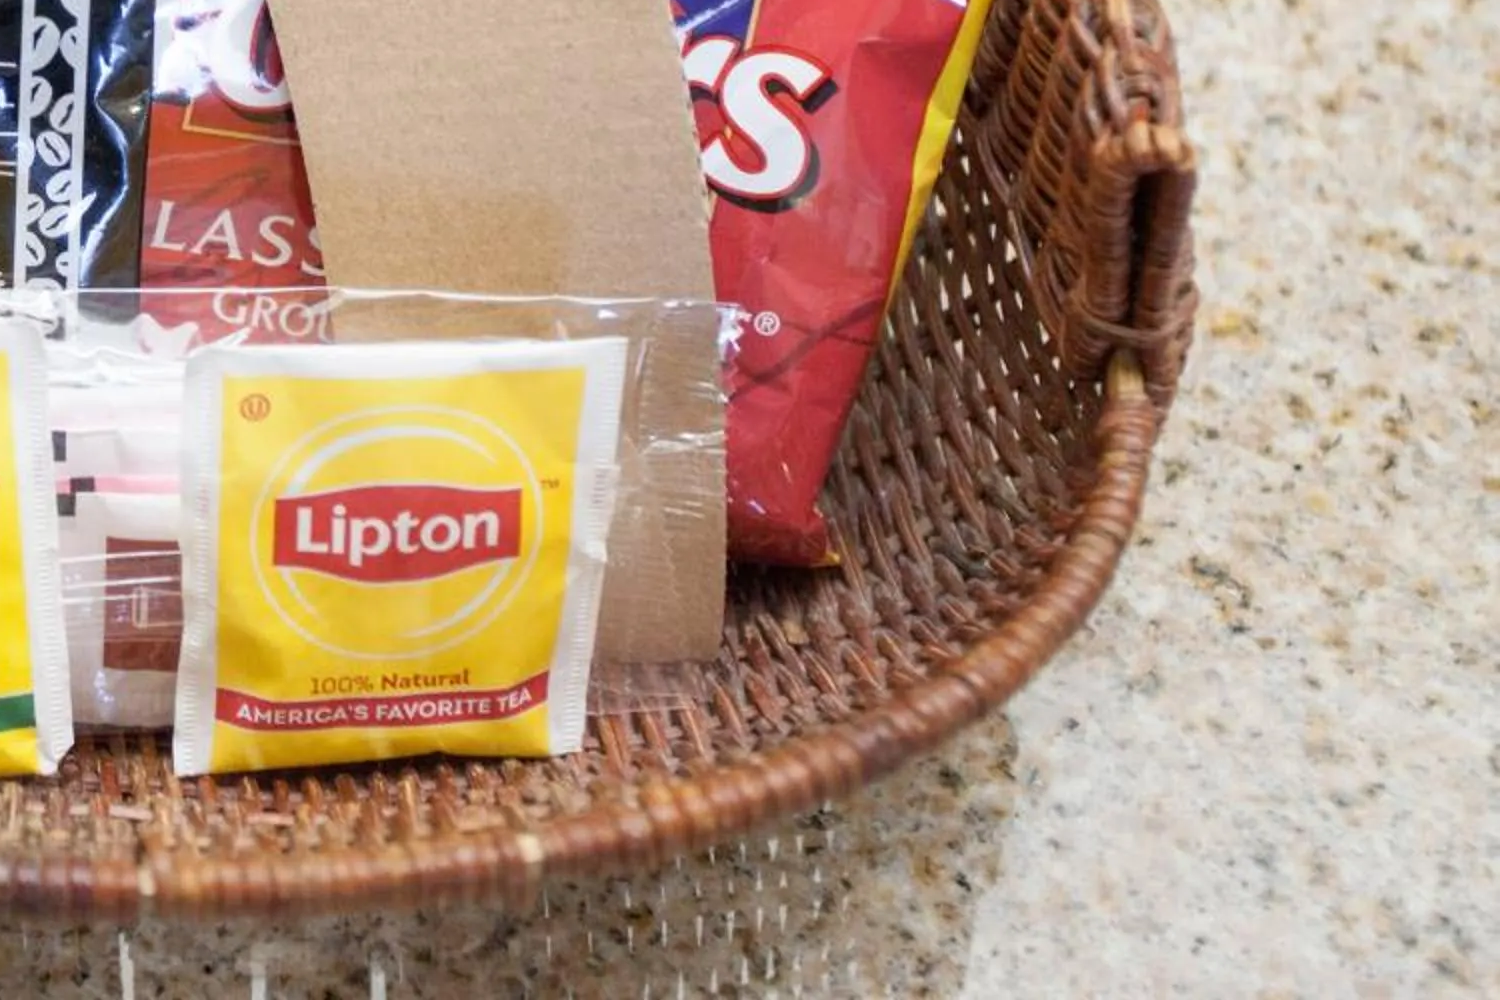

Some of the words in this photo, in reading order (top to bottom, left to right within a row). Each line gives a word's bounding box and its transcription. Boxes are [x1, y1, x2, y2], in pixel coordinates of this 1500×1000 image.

[296, 504, 499, 567] Lipton
[311, 673, 374, 695] 100%
[381, 669, 470, 691] Natural
[236, 702, 369, 725] AMERICA'S
[375, 696, 491, 722] FAVORITE
[498, 686, 532, 713] TEA
